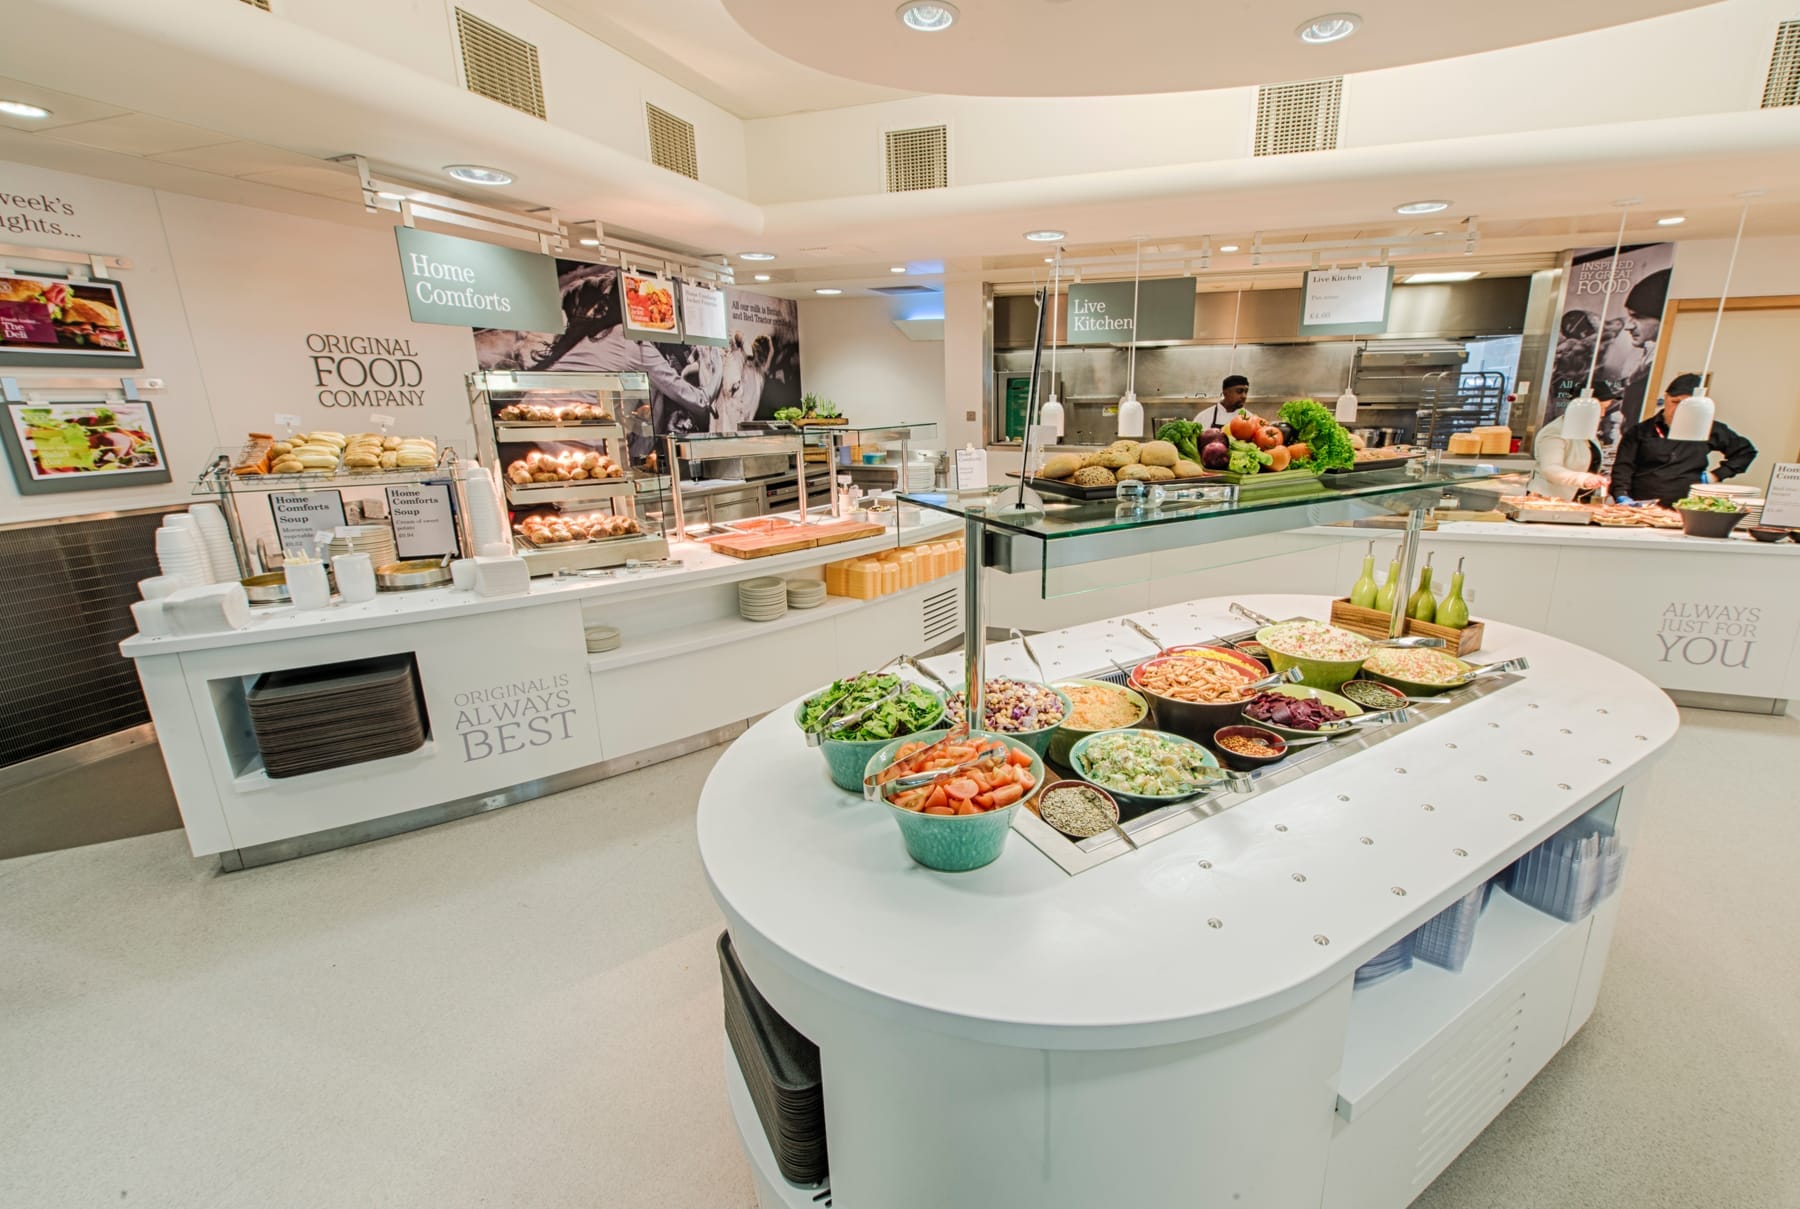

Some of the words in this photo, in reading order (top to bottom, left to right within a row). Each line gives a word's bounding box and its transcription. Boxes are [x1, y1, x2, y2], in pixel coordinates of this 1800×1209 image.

[409, 252, 475, 283] Home
[1580, 271, 1594, 280] BY
[1331, 274, 1362, 282] Kitchen
[1576, 278, 1631, 295] FOOD
[416, 280, 512, 312] Comforts
[732, 300, 740, 310] All
[750, 304, 761, 313] milk
[1074, 298, 1106, 314] Live
[733, 312, 742, 320] and
[743, 312, 754, 322] Red
[1074, 315, 1134, 331] Kitchen
[2, 322, 25, 331] The
[4, 329, 28, 339] Deli
[306, 333, 419, 357] ORIGINAL
[308, 355, 422, 387] FOOD
[1560, 380, 1573, 388] All
[318, 389, 425, 407] COMPANY
[276, 496, 309, 504] Home
[391, 489, 420, 497] Home
[392, 497, 439, 505] Comforts
[278, 503, 330, 512] Comforts
[394, 508, 420, 516] Soup
[280, 515, 309, 524] Soup
[1662, 602, 1762, 623] ALWAYS
[1657, 618, 1709, 634] JUST
[1713, 621, 1757, 638] FOR
[1656, 633, 1757, 669] YOU
[454, 677, 550, 707] ORIGINAL
[552, 673, 569, 689] IS
[455, 689, 571, 731] ALWAYS
[458, 709, 576, 763] BEST
